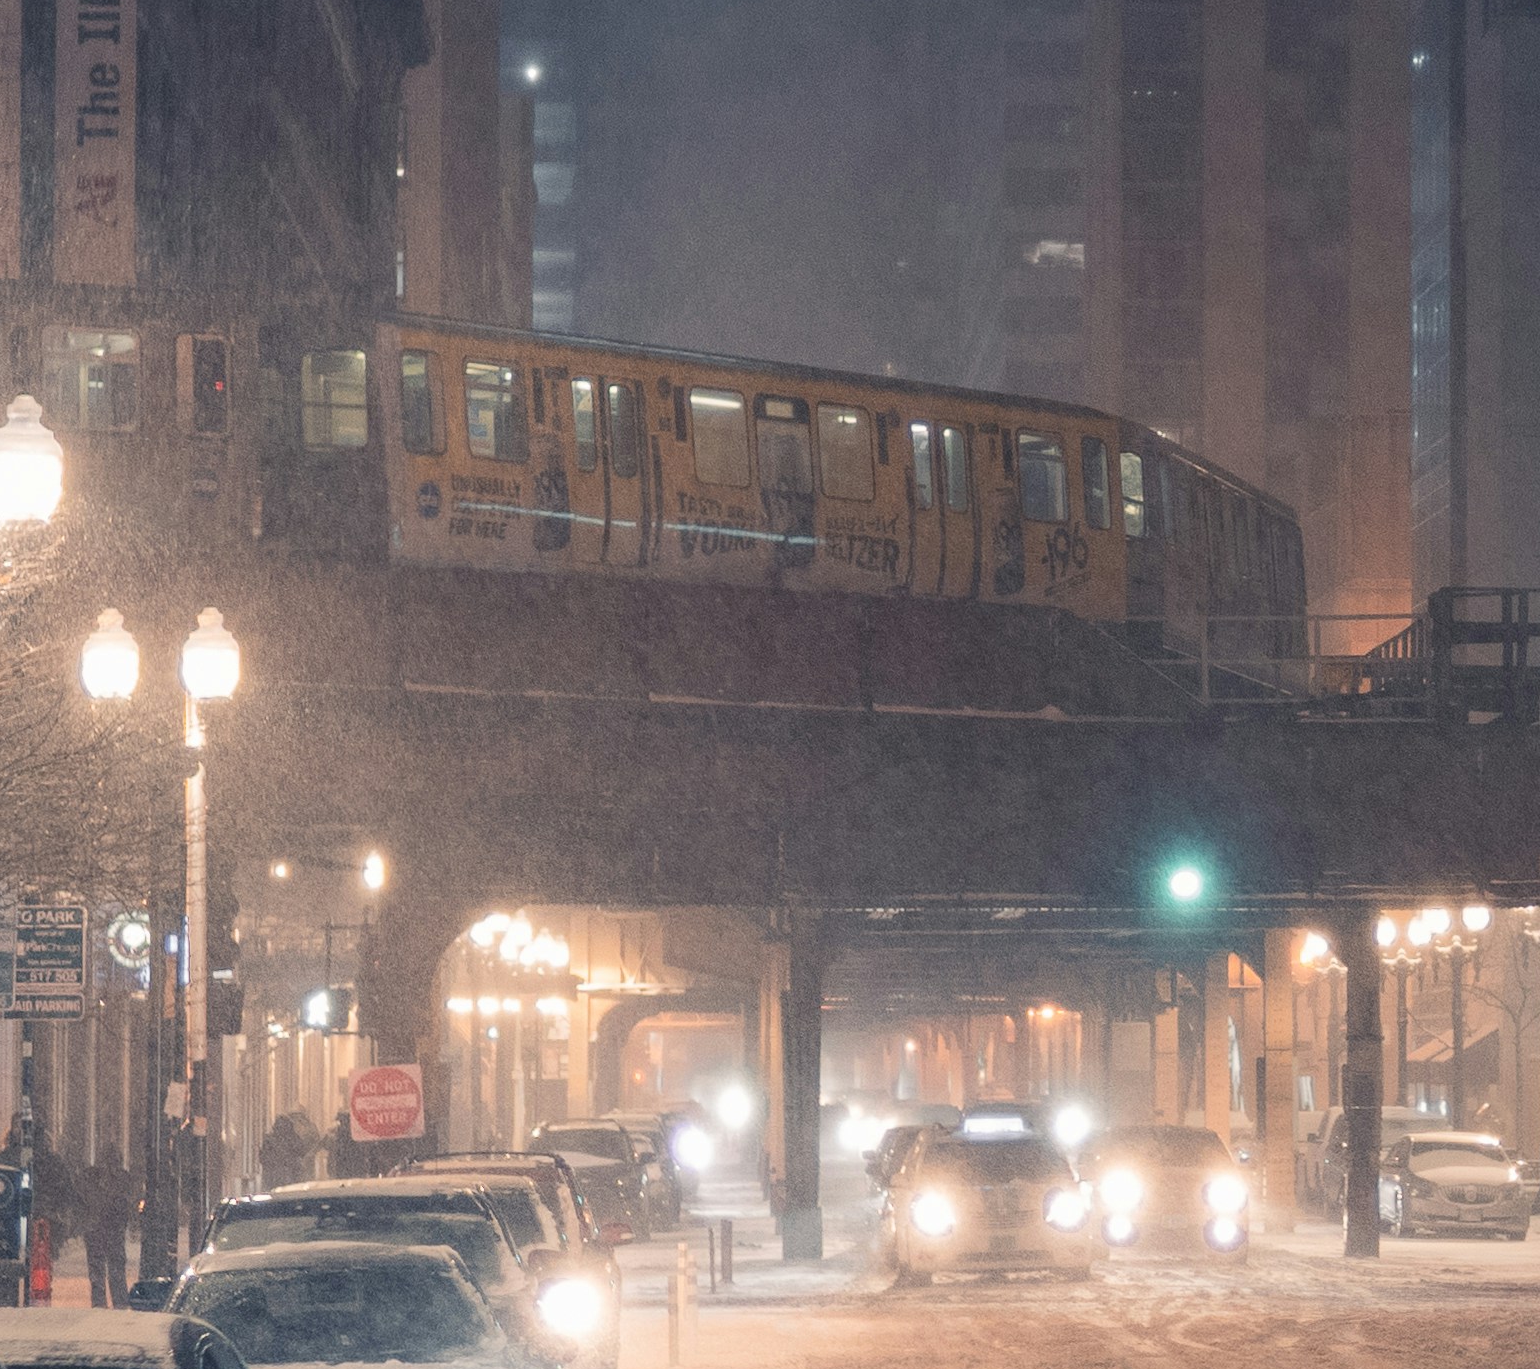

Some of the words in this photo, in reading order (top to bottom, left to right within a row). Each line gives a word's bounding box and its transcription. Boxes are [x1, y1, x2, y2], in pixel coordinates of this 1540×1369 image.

[76, 61, 120, 147] The
[36, 911, 76, 923] PARK
[15, 1000, 33, 1011] AID
[36, 1000, 81, 1011] PARKING
[359, 1081, 377, 1092] DO
[384, 1079, 411, 1091] NOT
[367, 1111, 408, 1124] ENTER
